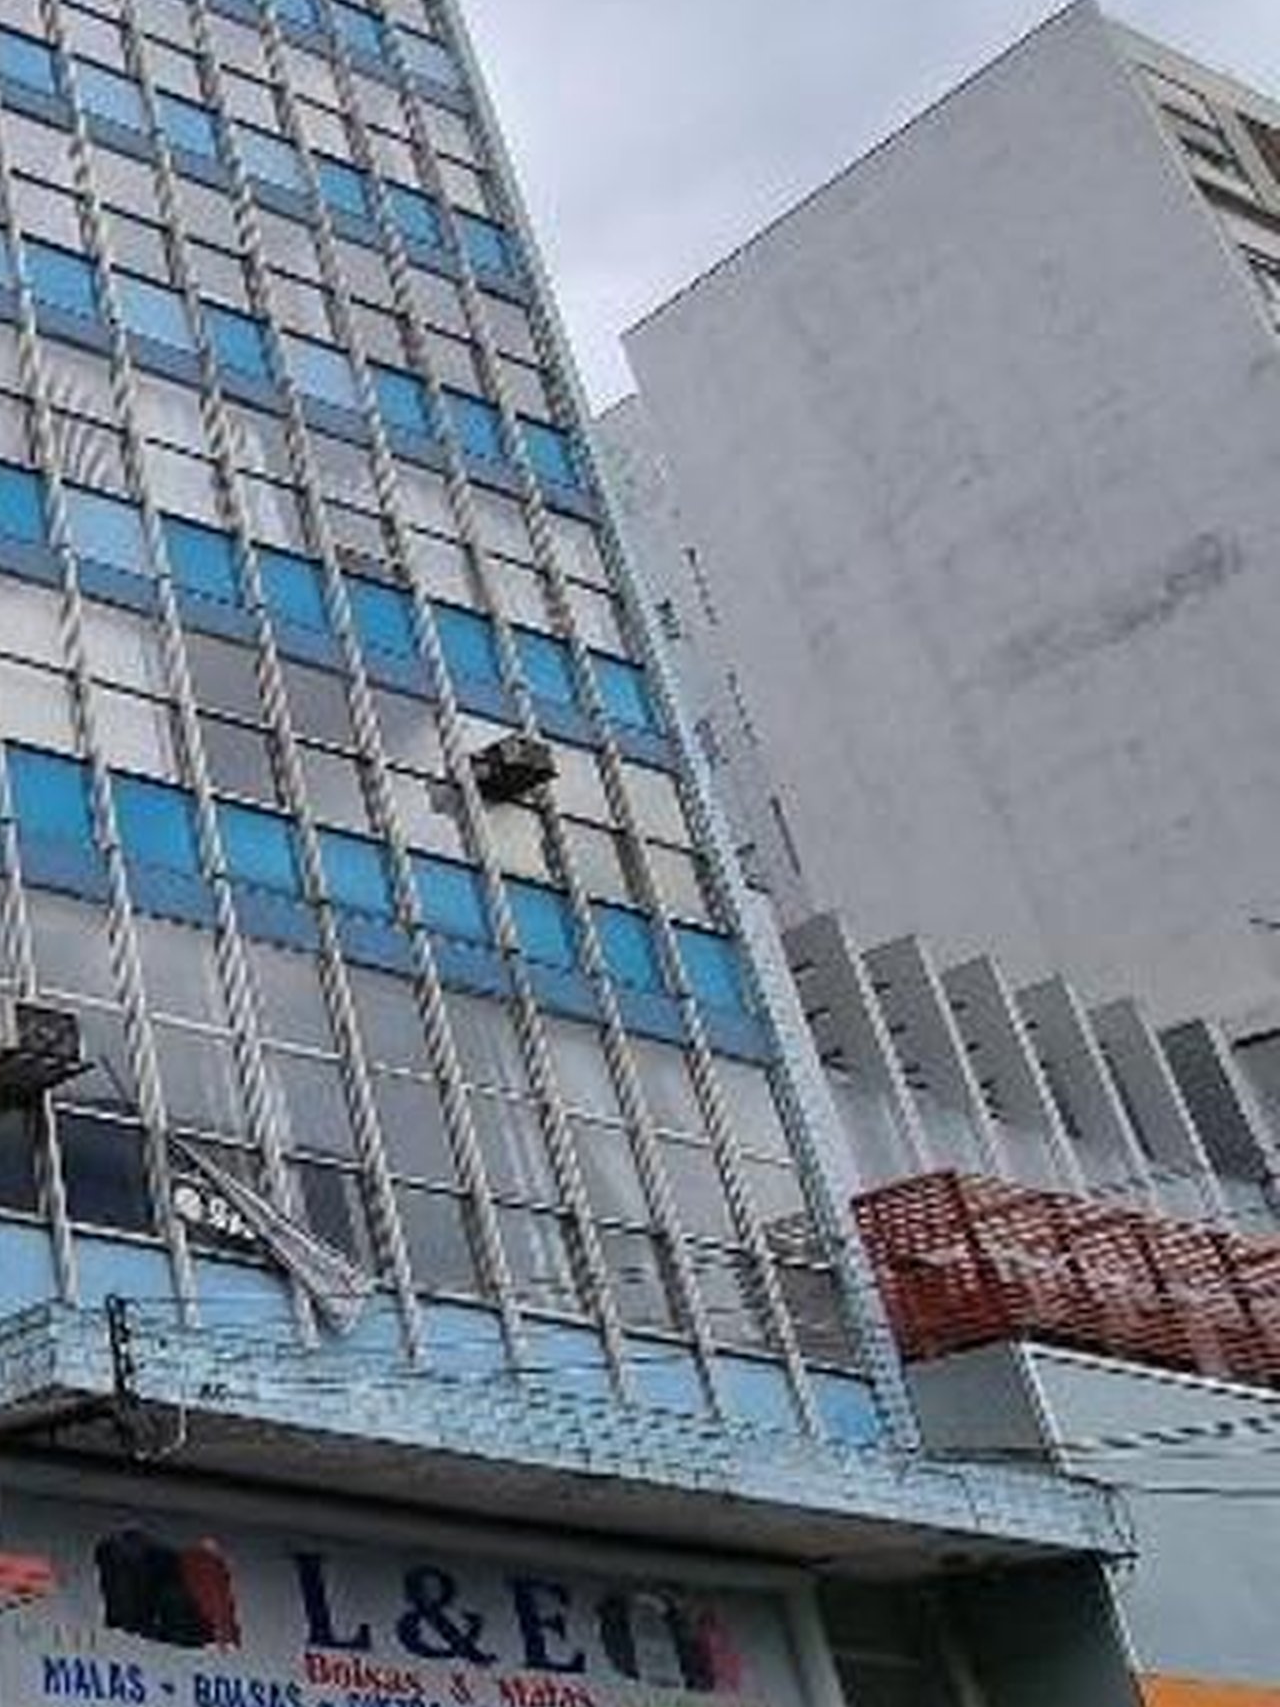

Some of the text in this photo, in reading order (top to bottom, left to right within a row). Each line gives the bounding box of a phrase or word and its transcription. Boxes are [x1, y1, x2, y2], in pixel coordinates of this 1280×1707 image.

[296, 1553, 585, 1674] L&E
[42, 1656, 146, 1704] MALAS
[304, 1652, 425, 1695] Bolsas
